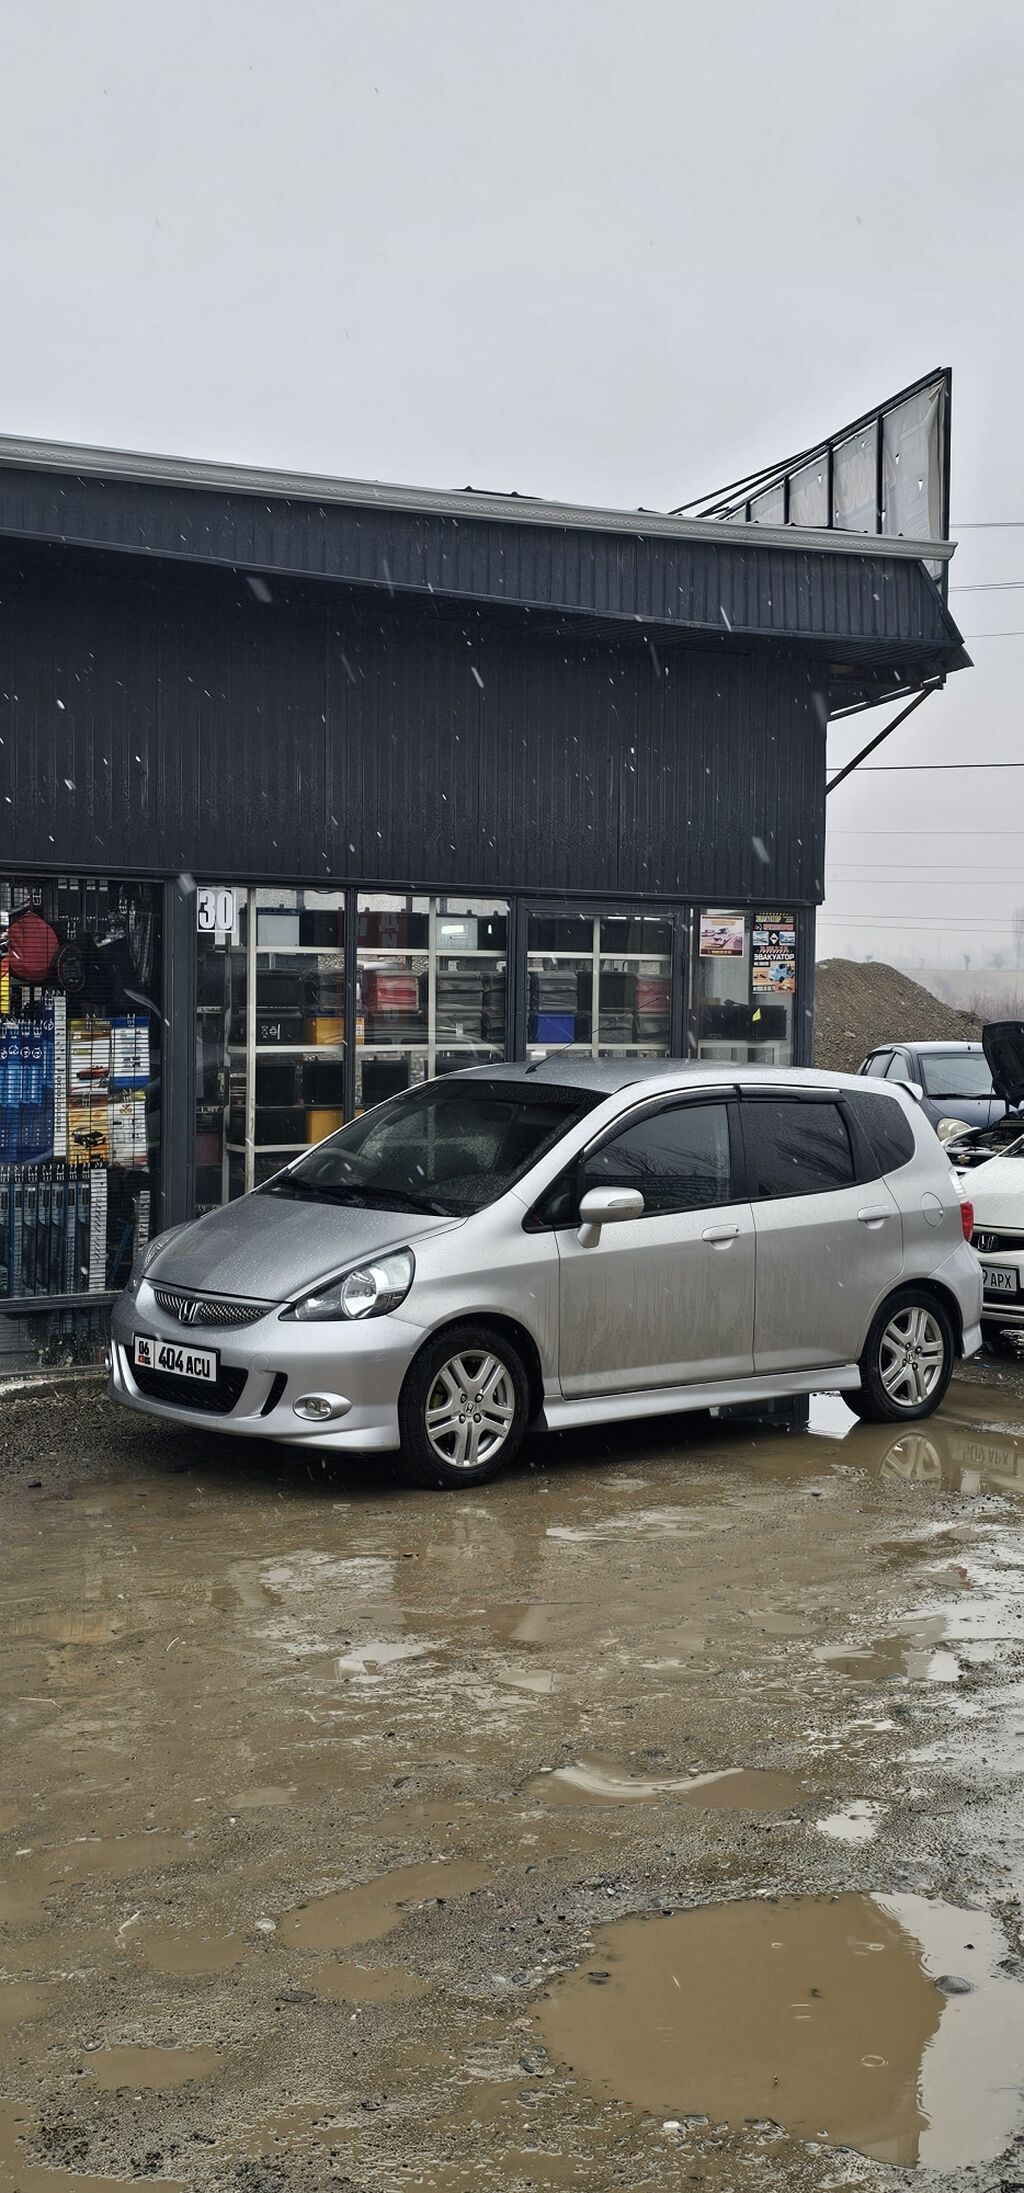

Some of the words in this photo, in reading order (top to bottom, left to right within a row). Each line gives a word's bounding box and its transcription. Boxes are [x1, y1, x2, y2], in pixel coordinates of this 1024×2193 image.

[198, 890, 234, 930] 30
[753, 953, 795, 961] ЭВАКУАТОР
[991, 1272, 1012, 1289] APX
[139, 1340, 150, 1356] 06
[158, 1346, 184, 1372] 404
[186, 1356, 210, 1378] ACU
